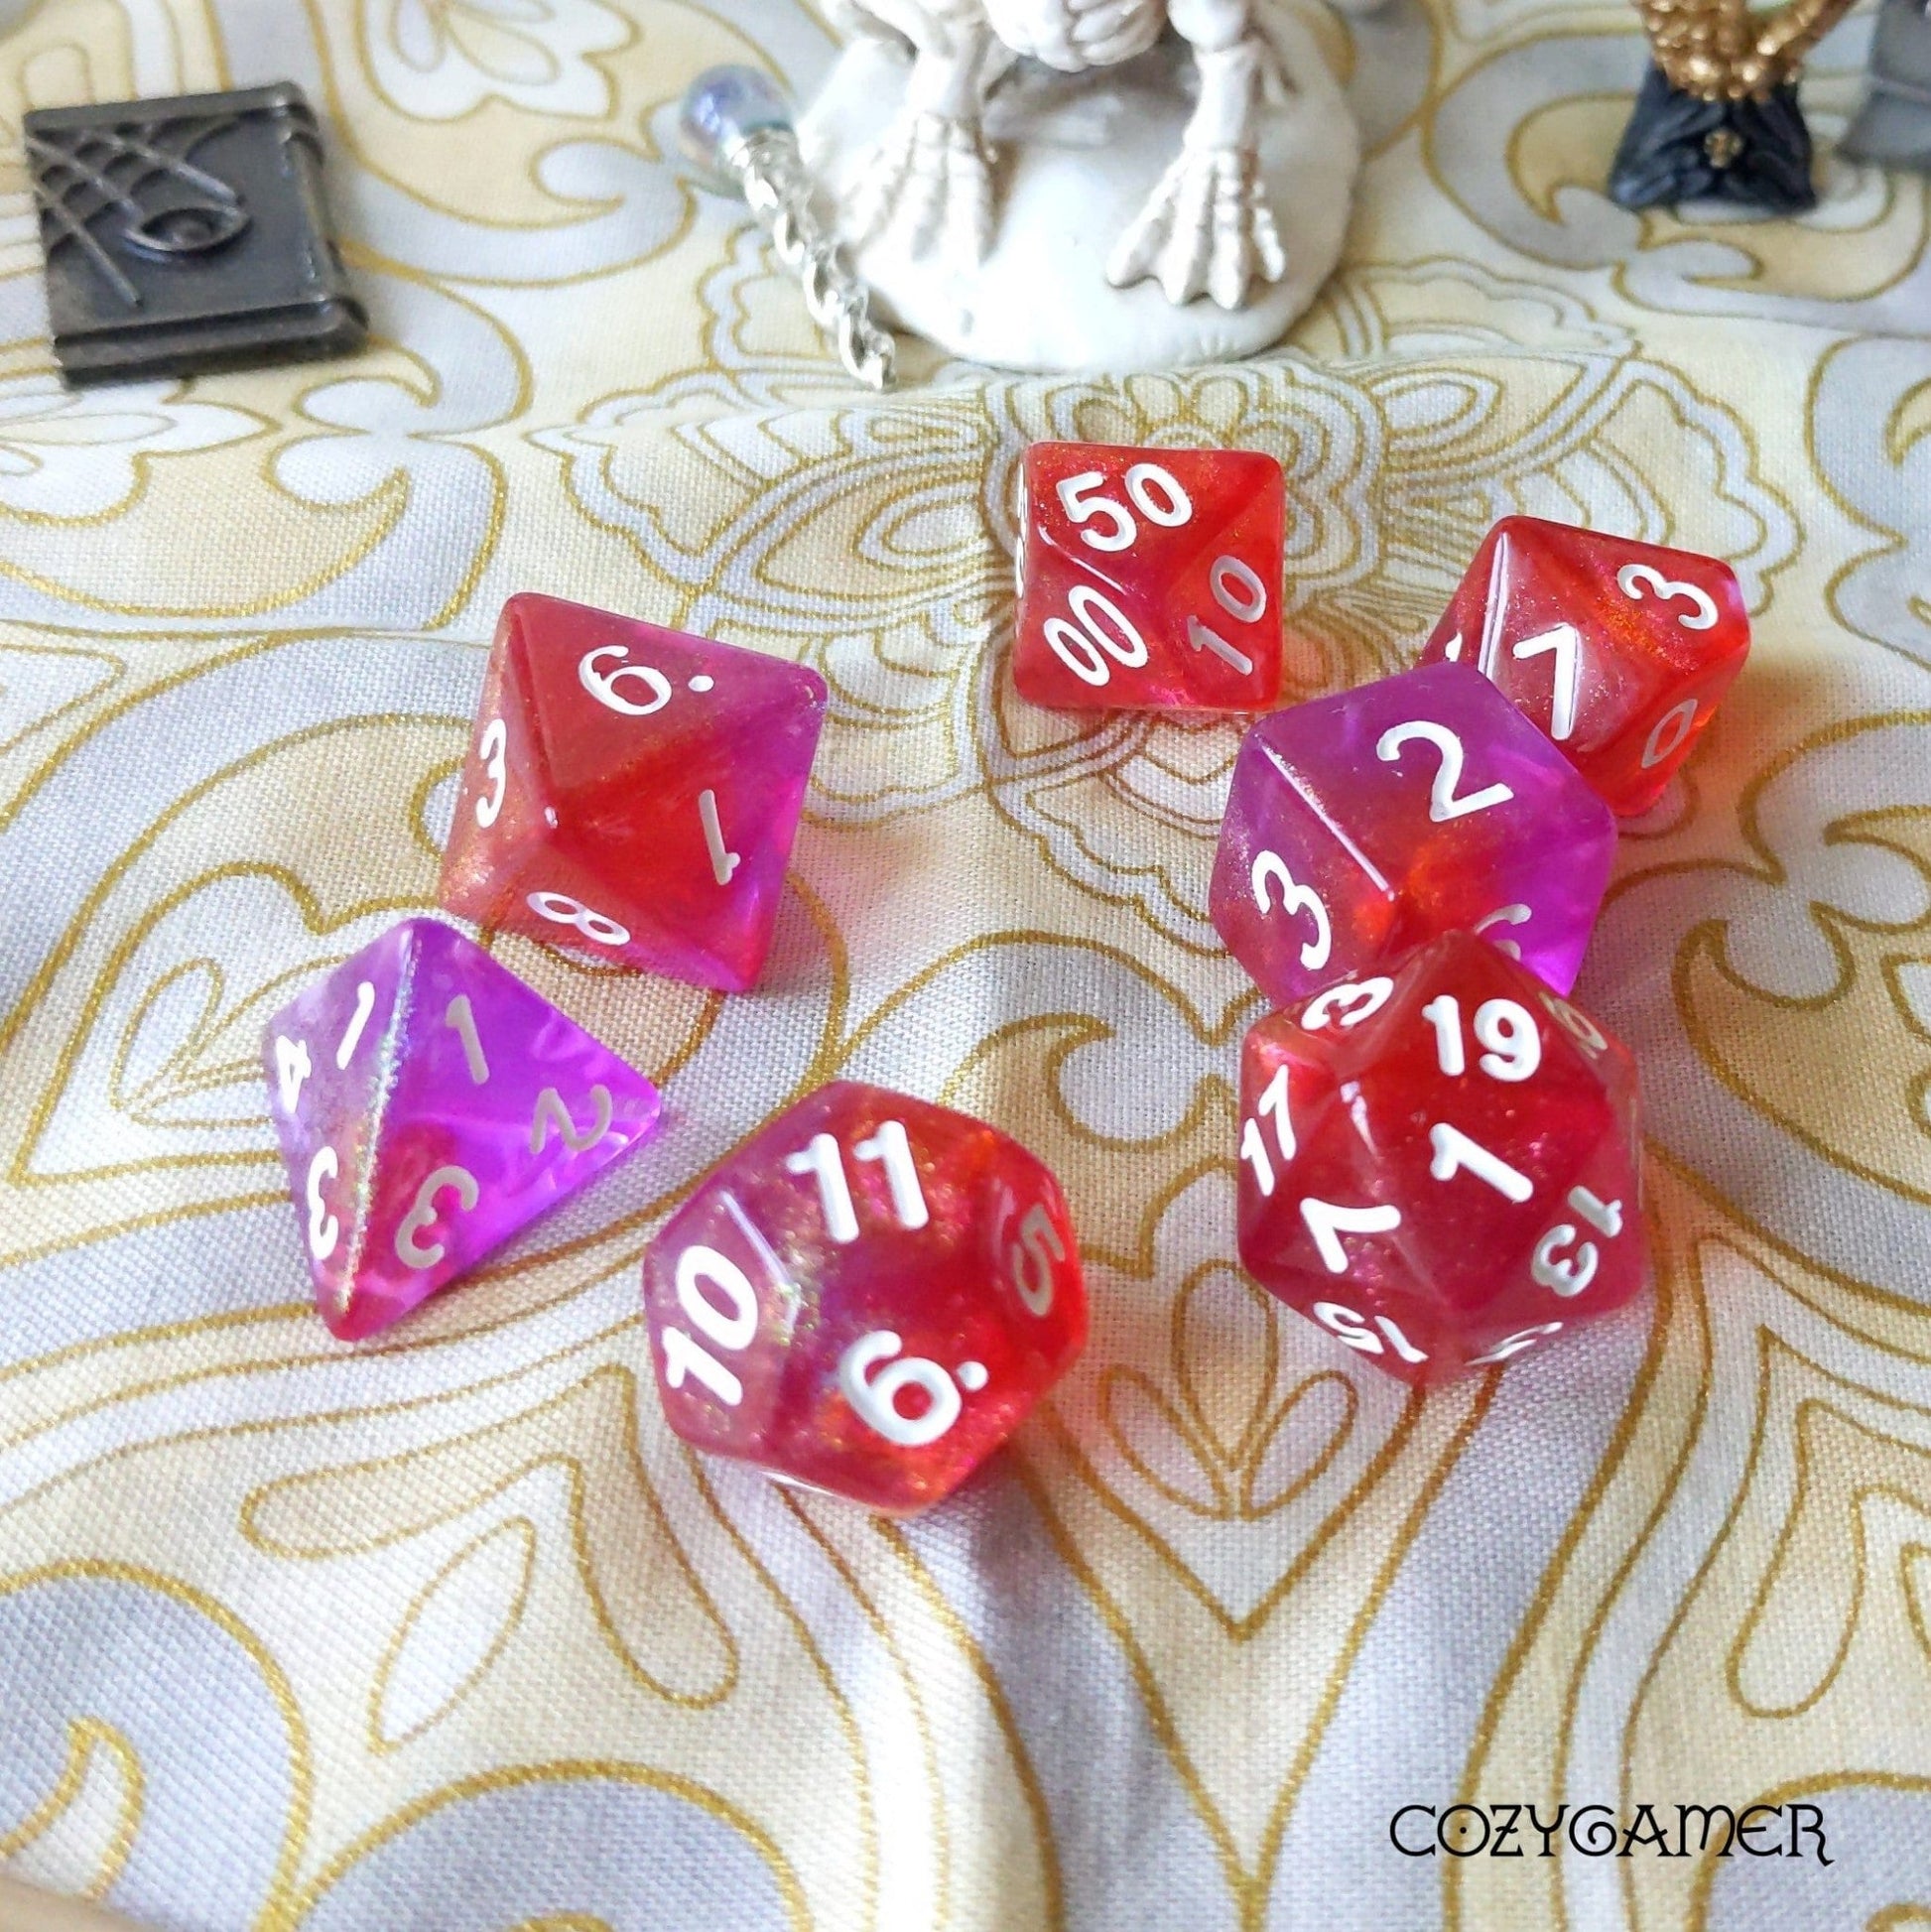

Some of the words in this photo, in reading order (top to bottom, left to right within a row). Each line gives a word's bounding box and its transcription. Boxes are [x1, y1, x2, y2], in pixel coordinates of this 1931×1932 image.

[1055, 462, 1193, 552] 50
[1043, 584, 1149, 687] 00
[1186, 555, 1267, 676] 10
[1616, 563, 1719, 630] 3
[1512, 621, 1580, 741] 7
[475, 717, 508, 829] 3
[1375, 719, 1514, 823] 2
[1640, 698, 1699, 770] 0
[699, 788, 741, 886] 1
[525, 891, 631, 947] 8
[1250, 848, 1333, 971] 3
[335, 980, 376, 1071] 1
[445, 993, 490, 1086] 1
[1301, 975, 1394, 1031] 3
[1421, 993, 1543, 1084] 19
[275, 1034, 313, 1114] 4
[529, 1083, 614, 1155] 2
[1239, 1063, 1297, 1198] 17
[1429, 1121, 1534, 1203] 1
[307, 1145, 339, 1260] 3
[395, 1164, 480, 1270] 3
[785, 1118, 931, 1245] 11
[1011, 1202, 1066, 1318] 5
[1299, 1196, 1402, 1275] 7
[1530, 1185, 1624, 1298] 13
[661, 1244, 759, 1407] 10
[1313, 1300, 1430, 1364] 15
